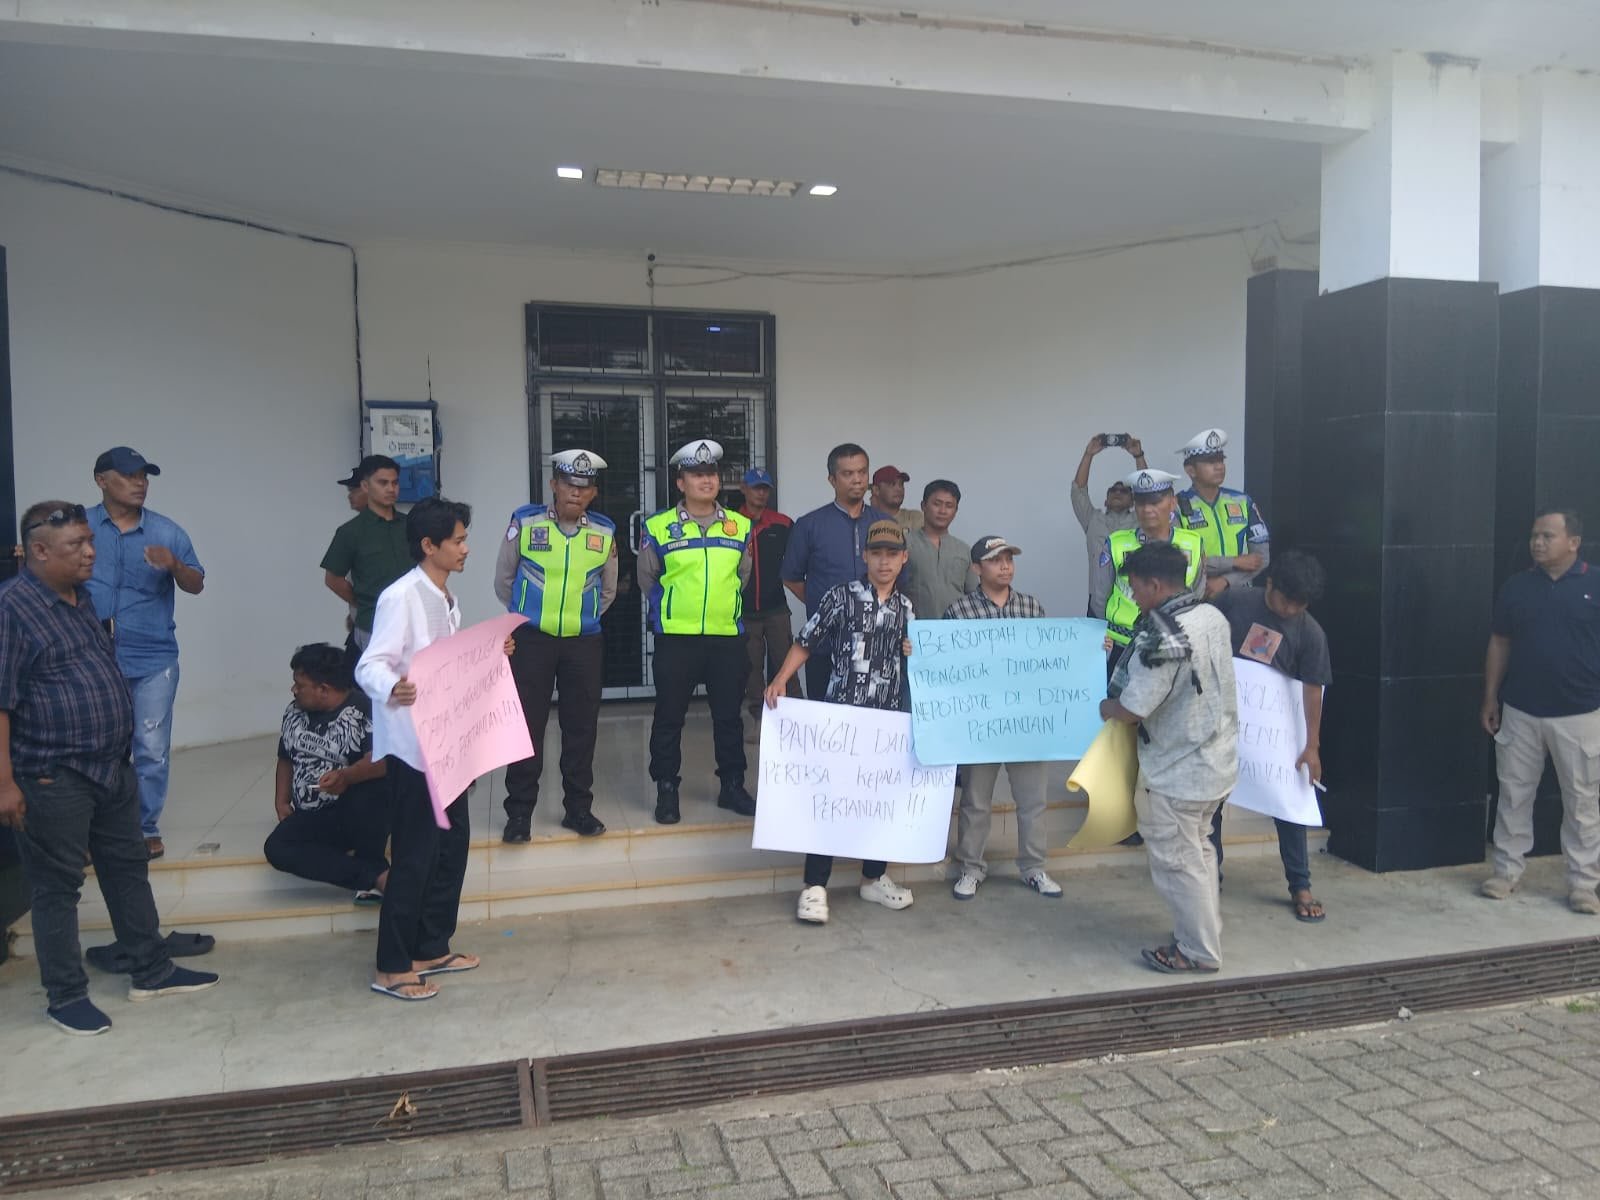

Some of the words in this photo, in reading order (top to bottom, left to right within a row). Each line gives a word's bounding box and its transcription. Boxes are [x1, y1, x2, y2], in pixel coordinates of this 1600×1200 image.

[1025, 626, 1080, 649] UNTUK
[1004, 689, 1023, 706] DI
[1038, 688, 1090, 706] DINAS
[779, 717, 860, 757] PANGGIL
[911, 768, 953, 789] DINAS
[812, 793, 895, 824] PERTANIAN
